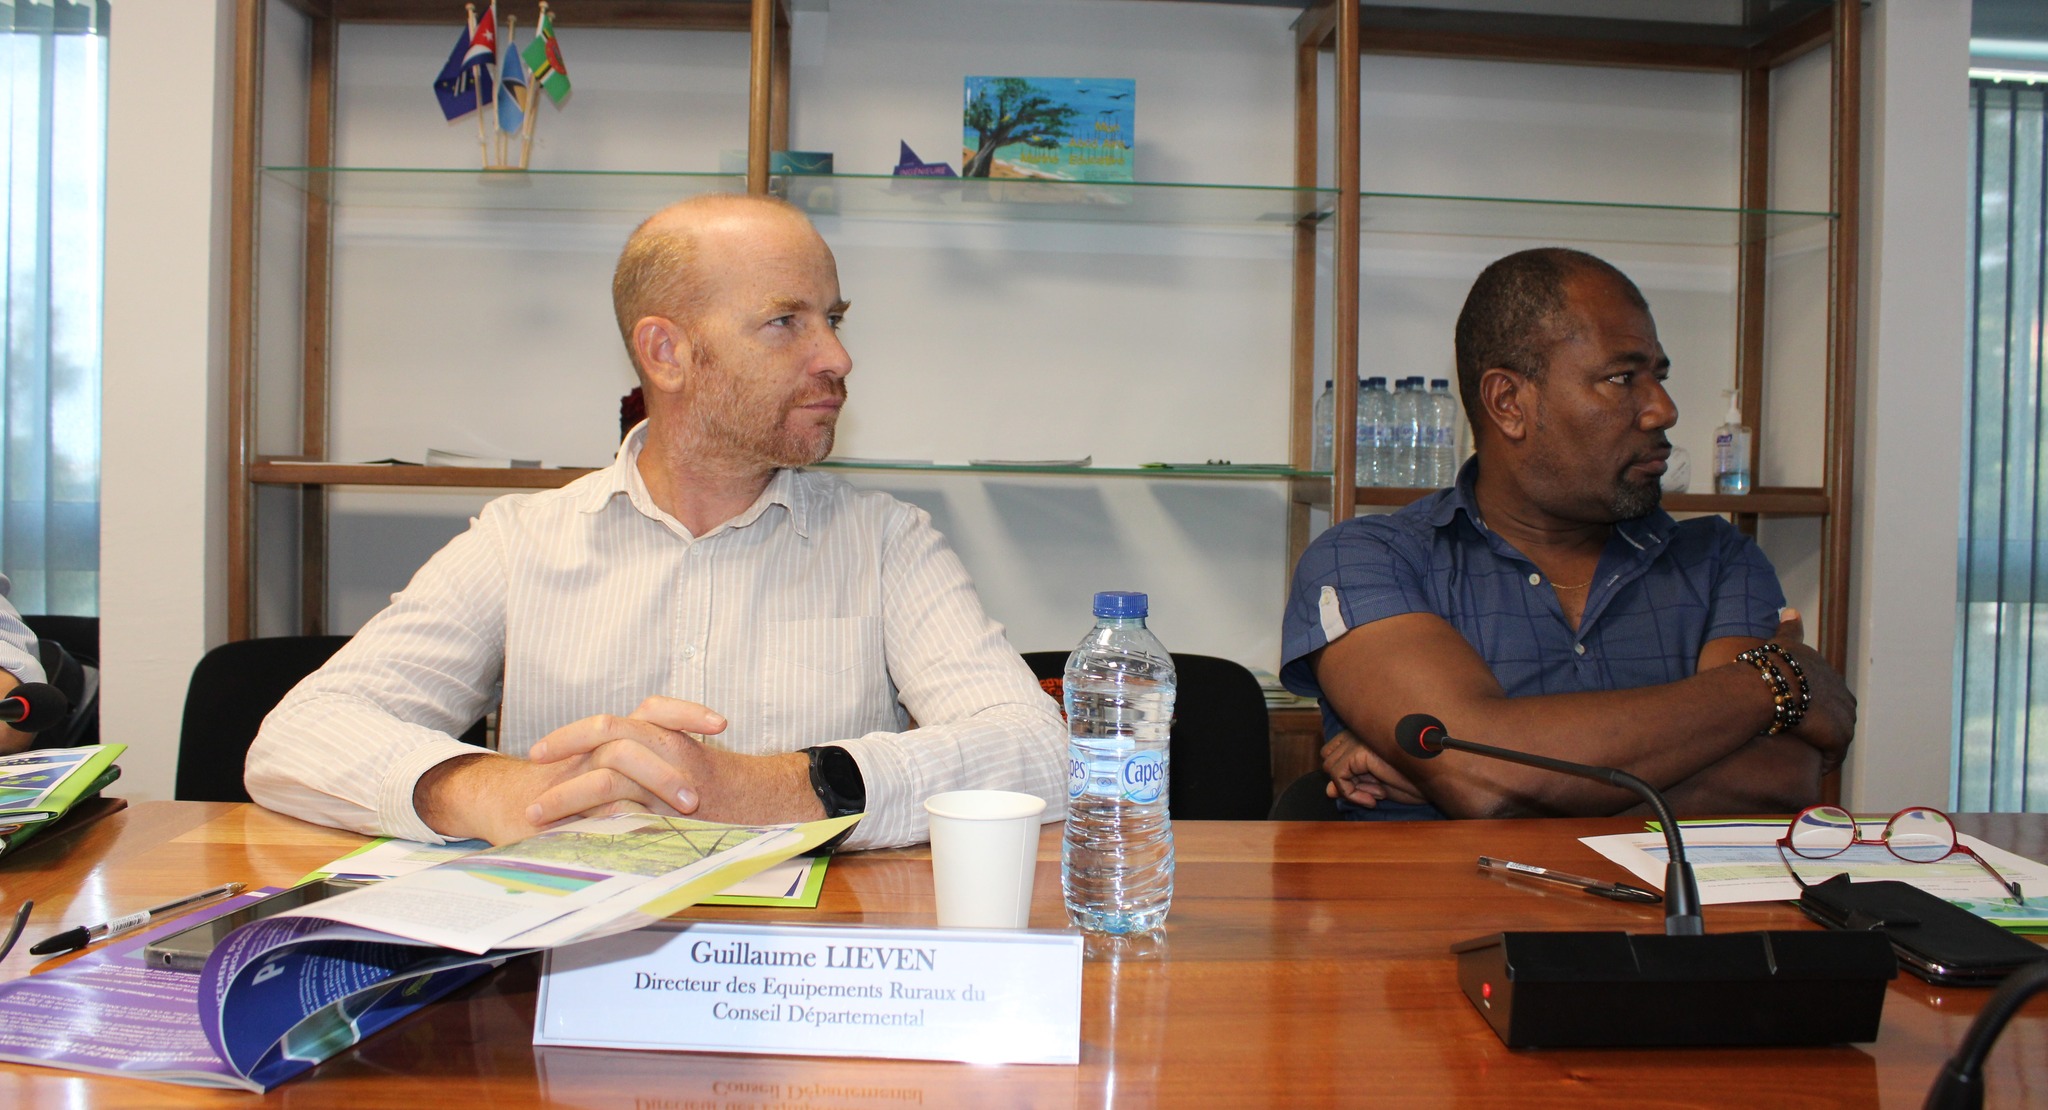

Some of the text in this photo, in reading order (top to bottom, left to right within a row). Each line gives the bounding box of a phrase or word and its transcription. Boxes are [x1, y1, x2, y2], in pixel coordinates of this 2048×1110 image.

[690, 940, 937, 971] Guillaume LIEVEN
[634, 972, 986, 1002] Directeur des Equipements Ruraux du
[712, 1002, 925, 1028] Conseil Départemental
